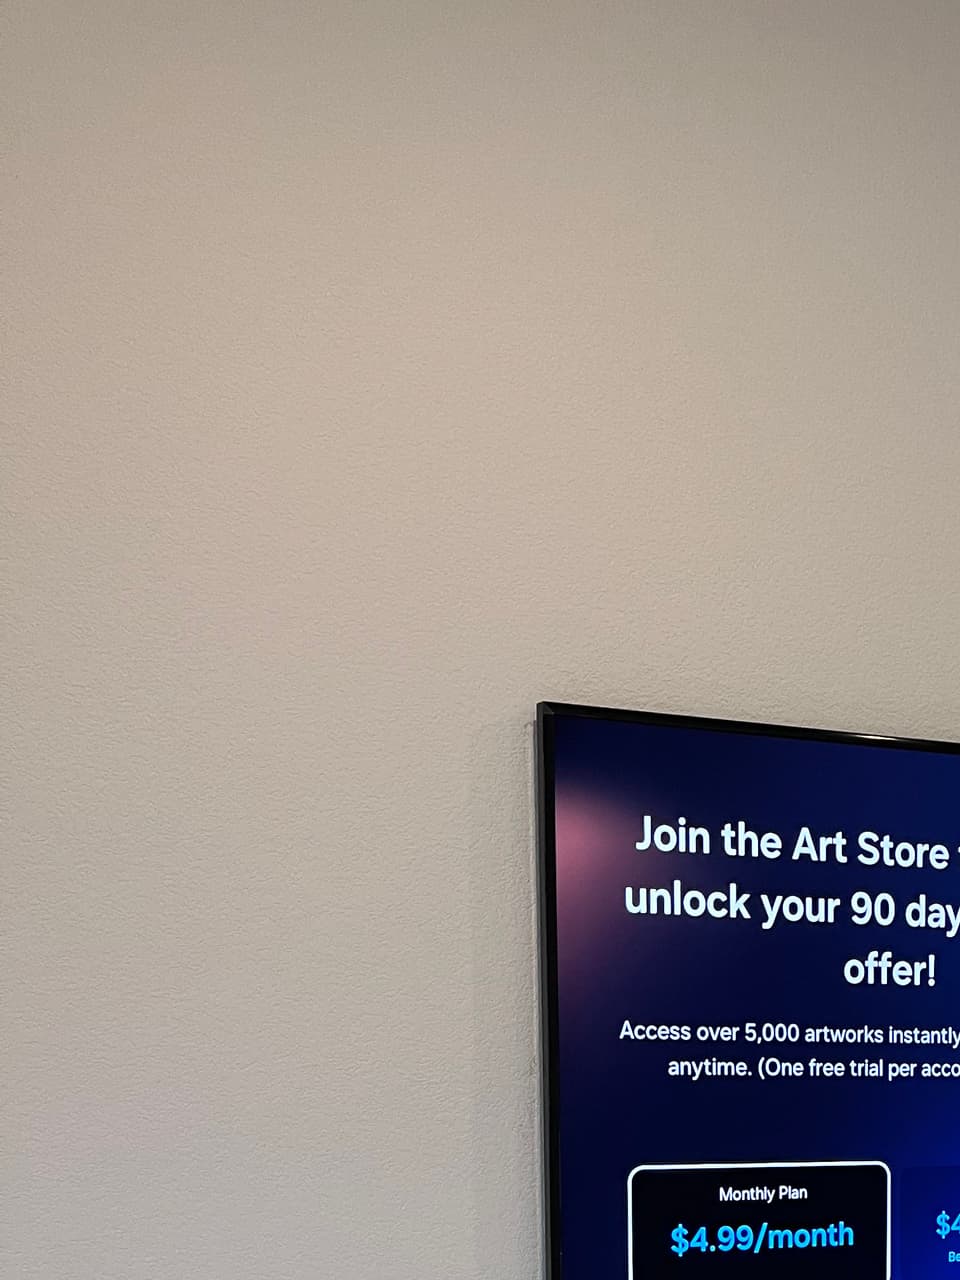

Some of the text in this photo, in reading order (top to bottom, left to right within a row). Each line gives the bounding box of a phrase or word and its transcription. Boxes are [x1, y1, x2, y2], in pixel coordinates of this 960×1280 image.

[635, 815, 710, 854] Join
[721, 822, 782, 859] the
[791, 826, 848, 865] Art
[857, 830, 950, 871] Store
[624, 879, 751, 920] unlock
[760, 889, 841, 929] your
[850, 891, 896, 926] 90
[843, 950, 937, 987] offer!
[618, 1020, 691, 1042] Access
[696, 1024, 740, 1042] over
[744, 1022, 800, 1046] 5,000
[804, 1024, 884, 1044] artworks
[667, 1057, 753, 1080] anytime.
[757, 1057, 804, 1080] (One
[808, 1058, 846, 1078] free
[849, 1059, 883, 1078] trial
[887, 1061, 918, 1081] per
[719, 1185, 808, 1203] Monthly Plan
[670, 1221, 854, 1257] $4.99/month
